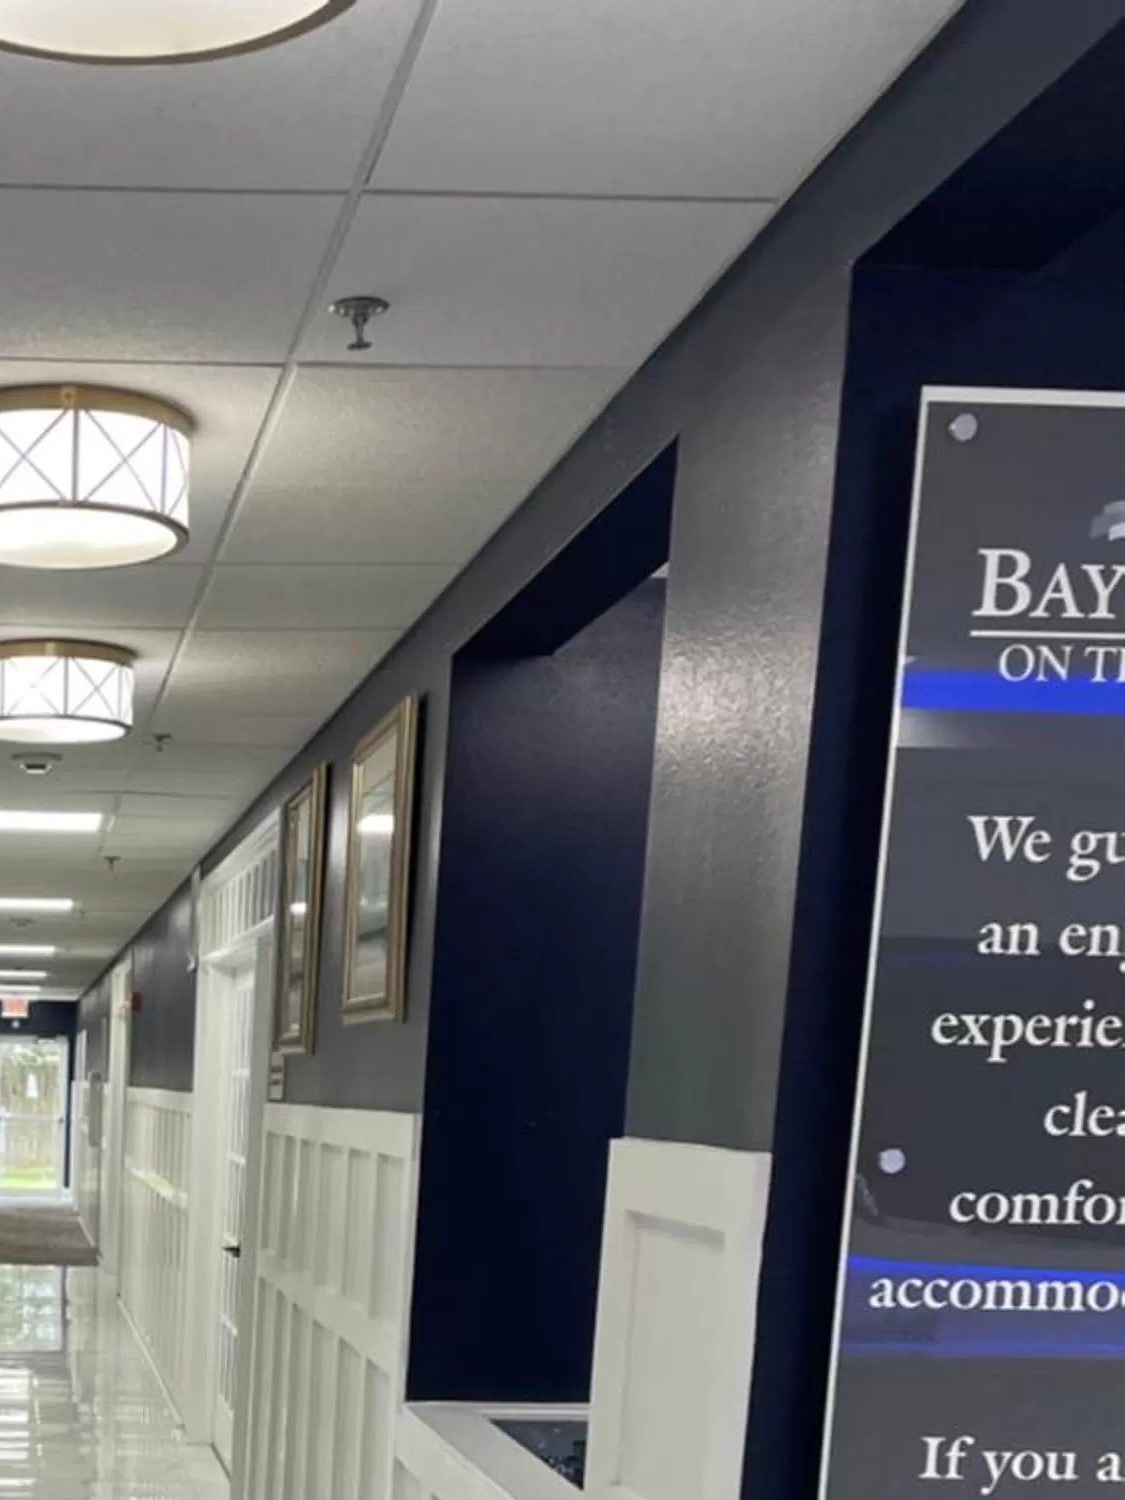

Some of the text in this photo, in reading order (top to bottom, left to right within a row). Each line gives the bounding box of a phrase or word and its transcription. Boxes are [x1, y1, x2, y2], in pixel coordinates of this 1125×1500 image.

[971, 548, 1125, 619] BAY
[999, 643, 1125, 683] ON T
[967, 815, 1052, 863] We
[977, 921, 1125, 973] an en
[930, 999, 1125, 1063] experie
[869, 1277, 1125, 1312] accommo
[919, 1435, 975, 1480] If
[980, 1449, 1079, 1496] you
